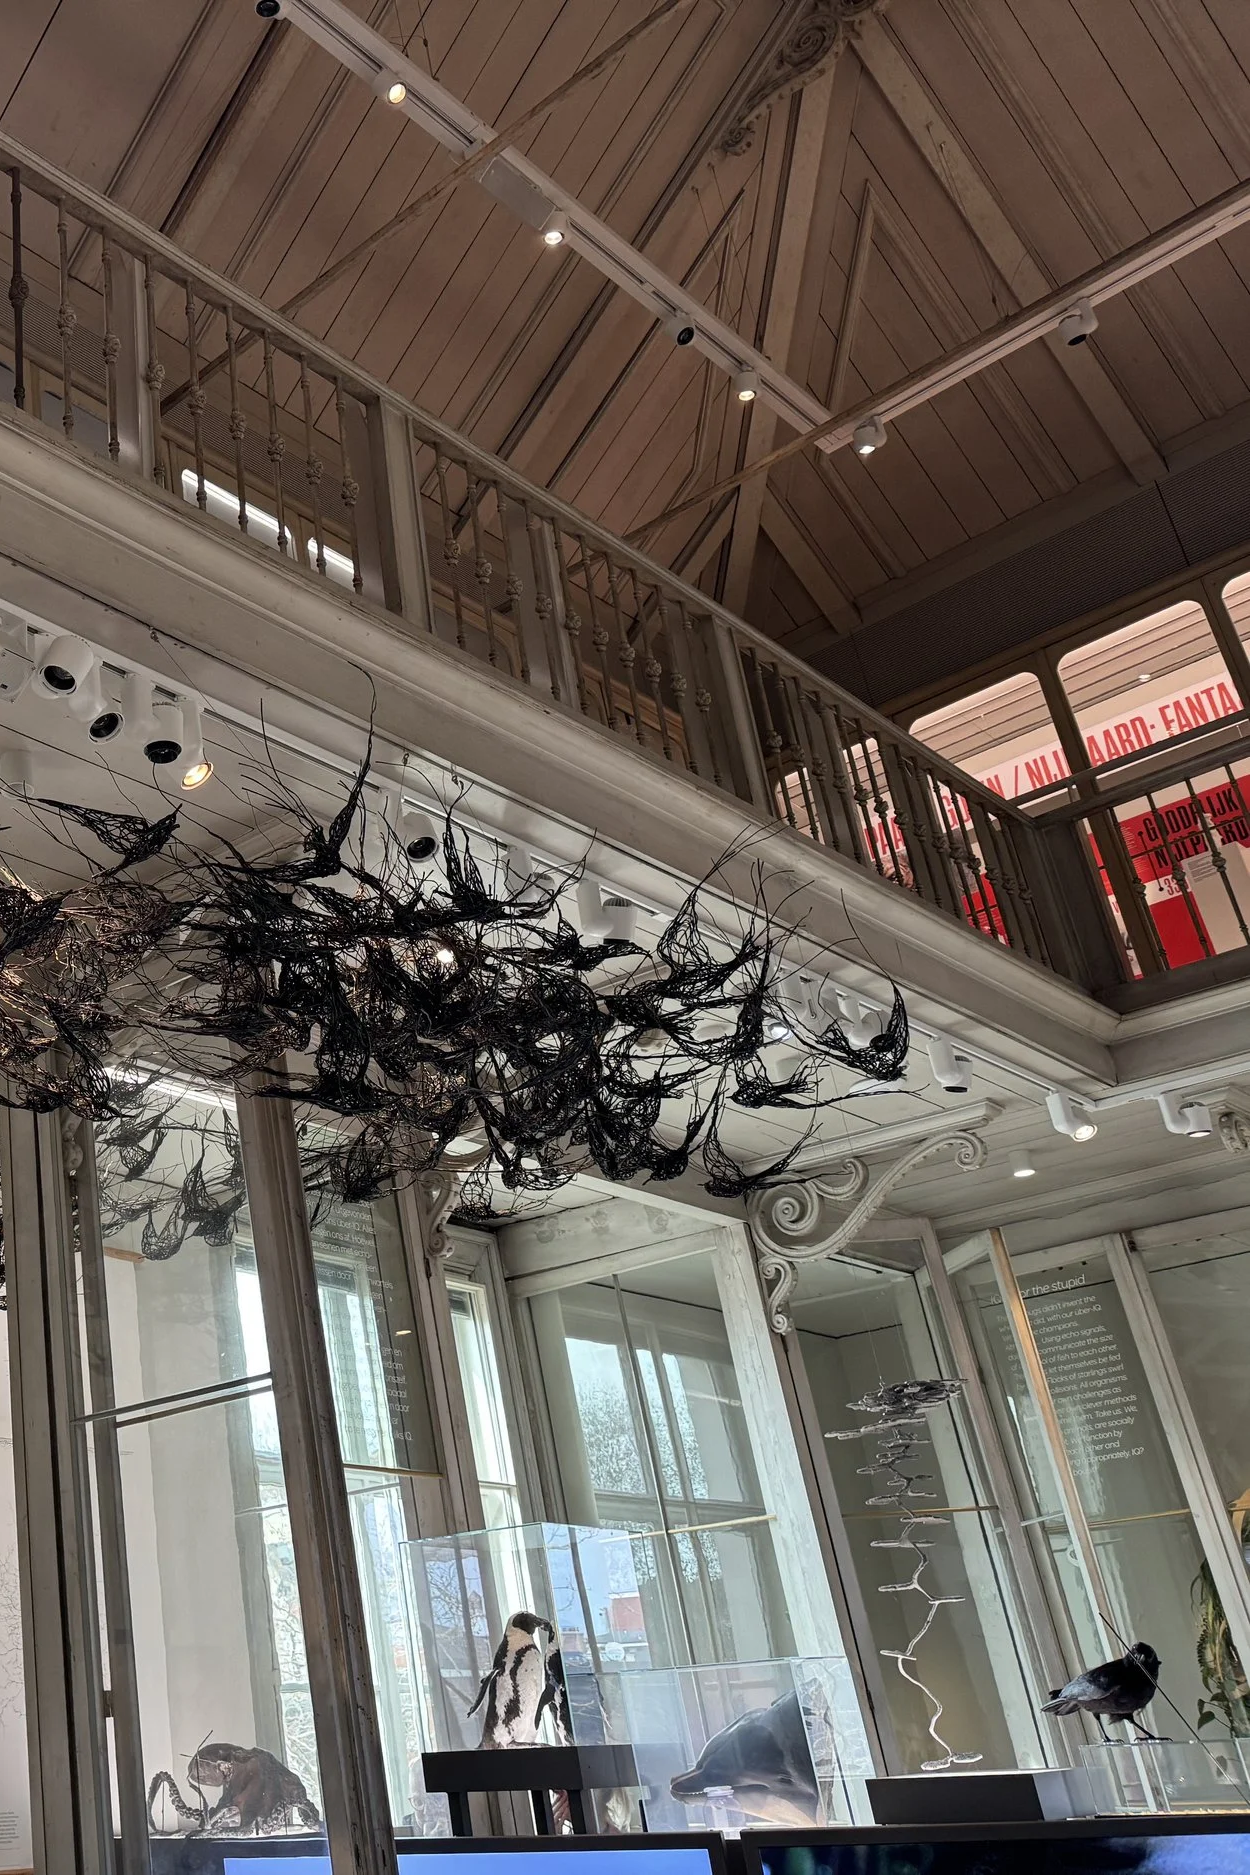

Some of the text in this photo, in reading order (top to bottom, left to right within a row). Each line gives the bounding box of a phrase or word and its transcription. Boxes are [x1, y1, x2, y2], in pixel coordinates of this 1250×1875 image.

[1158, 681, 1244, 734] FANTA
[1032, 1285, 1050, 1295] the
[1051, 1274, 1085, 1291] stupid
